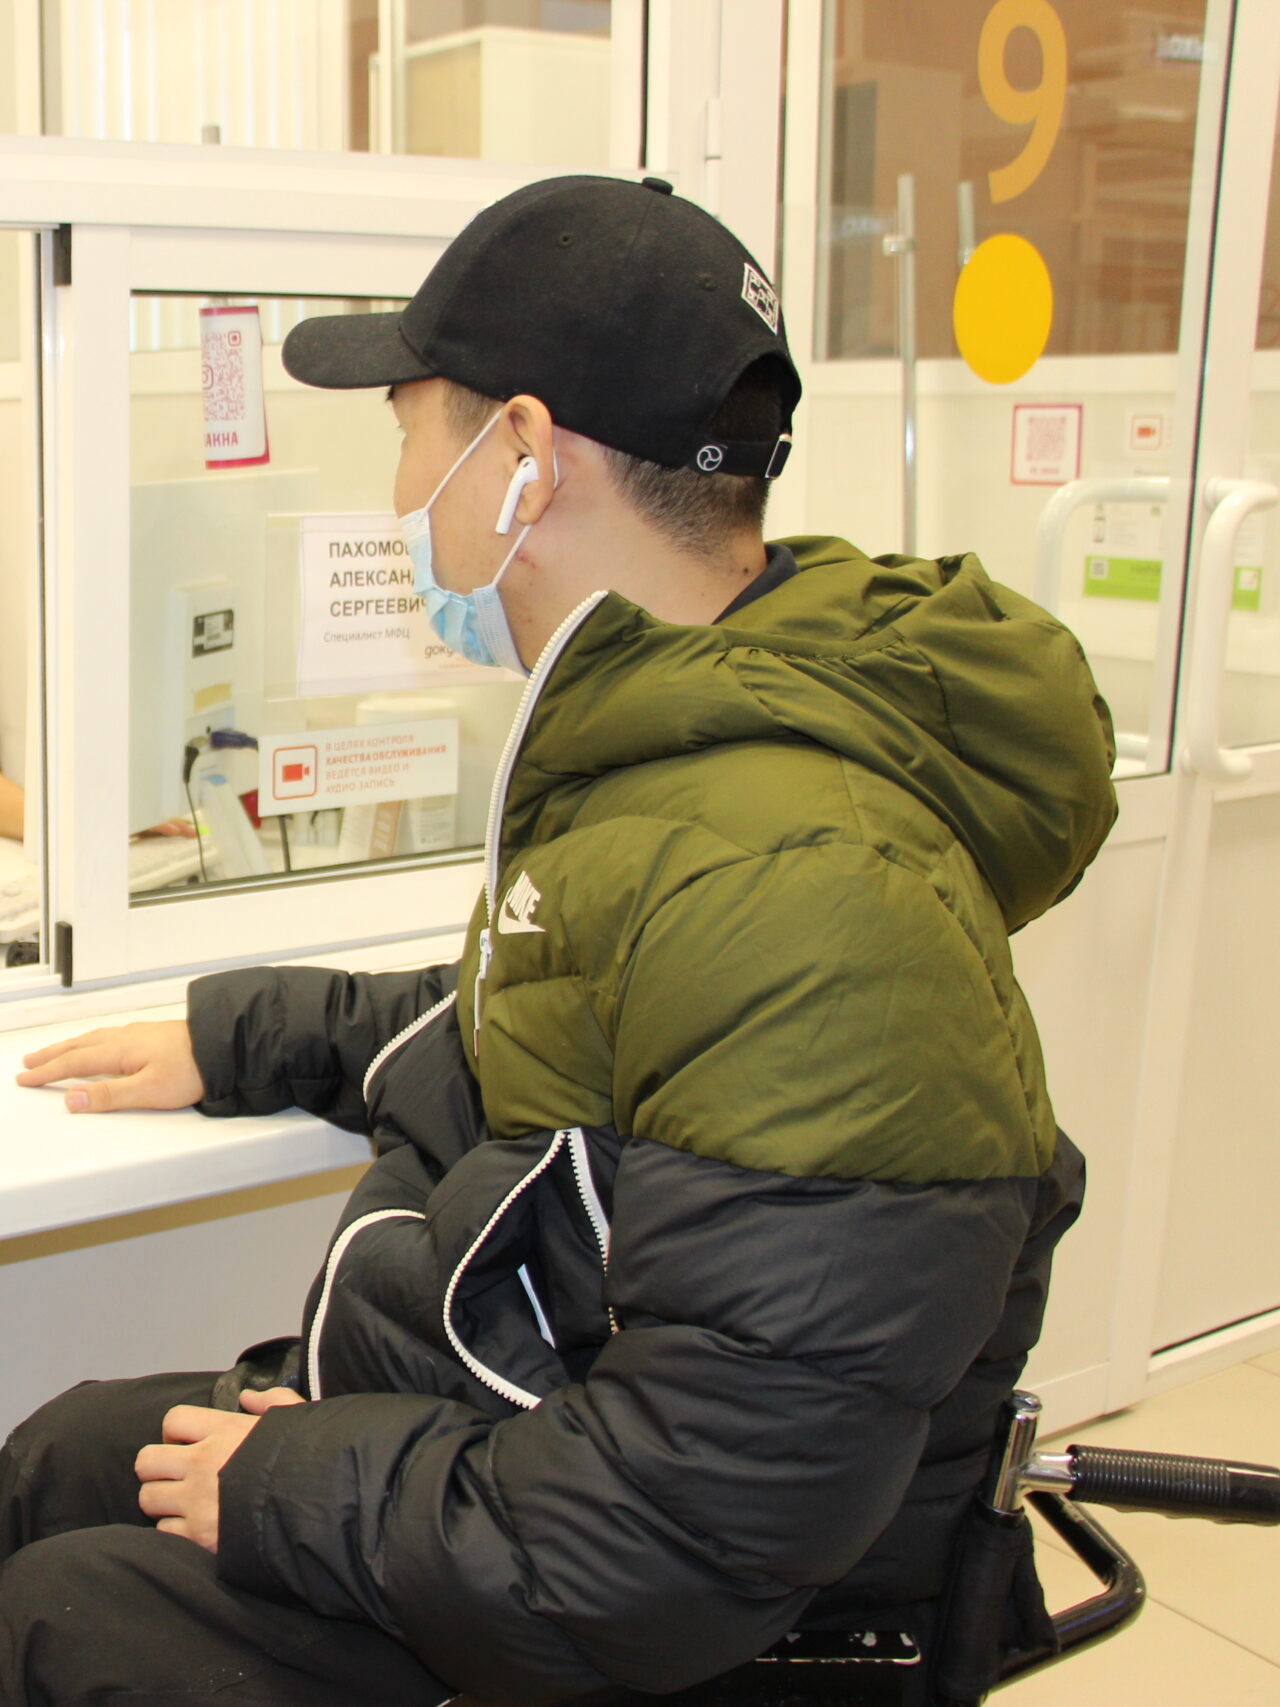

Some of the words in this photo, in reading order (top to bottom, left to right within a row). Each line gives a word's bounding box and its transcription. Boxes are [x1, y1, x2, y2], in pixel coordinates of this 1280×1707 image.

[978, 0, 1067, 204] 9
[329, 568, 415, 588] АЛЕКСАН
[323, 631, 383, 643] Специалист
[384, 626, 410, 640] МФЦ
[367, 734, 413, 747] КОНТРОЛЯ
[326, 753, 371, 765] КАЧЕСТВА
[373, 745, 447, 761] ОБСЛУЖИВАНИЯ
[369, 763, 399, 776] ВИДЕО
[326, 782, 356, 793] АУДИО
[358, 779, 395, 791] ЗАПИСЬ
